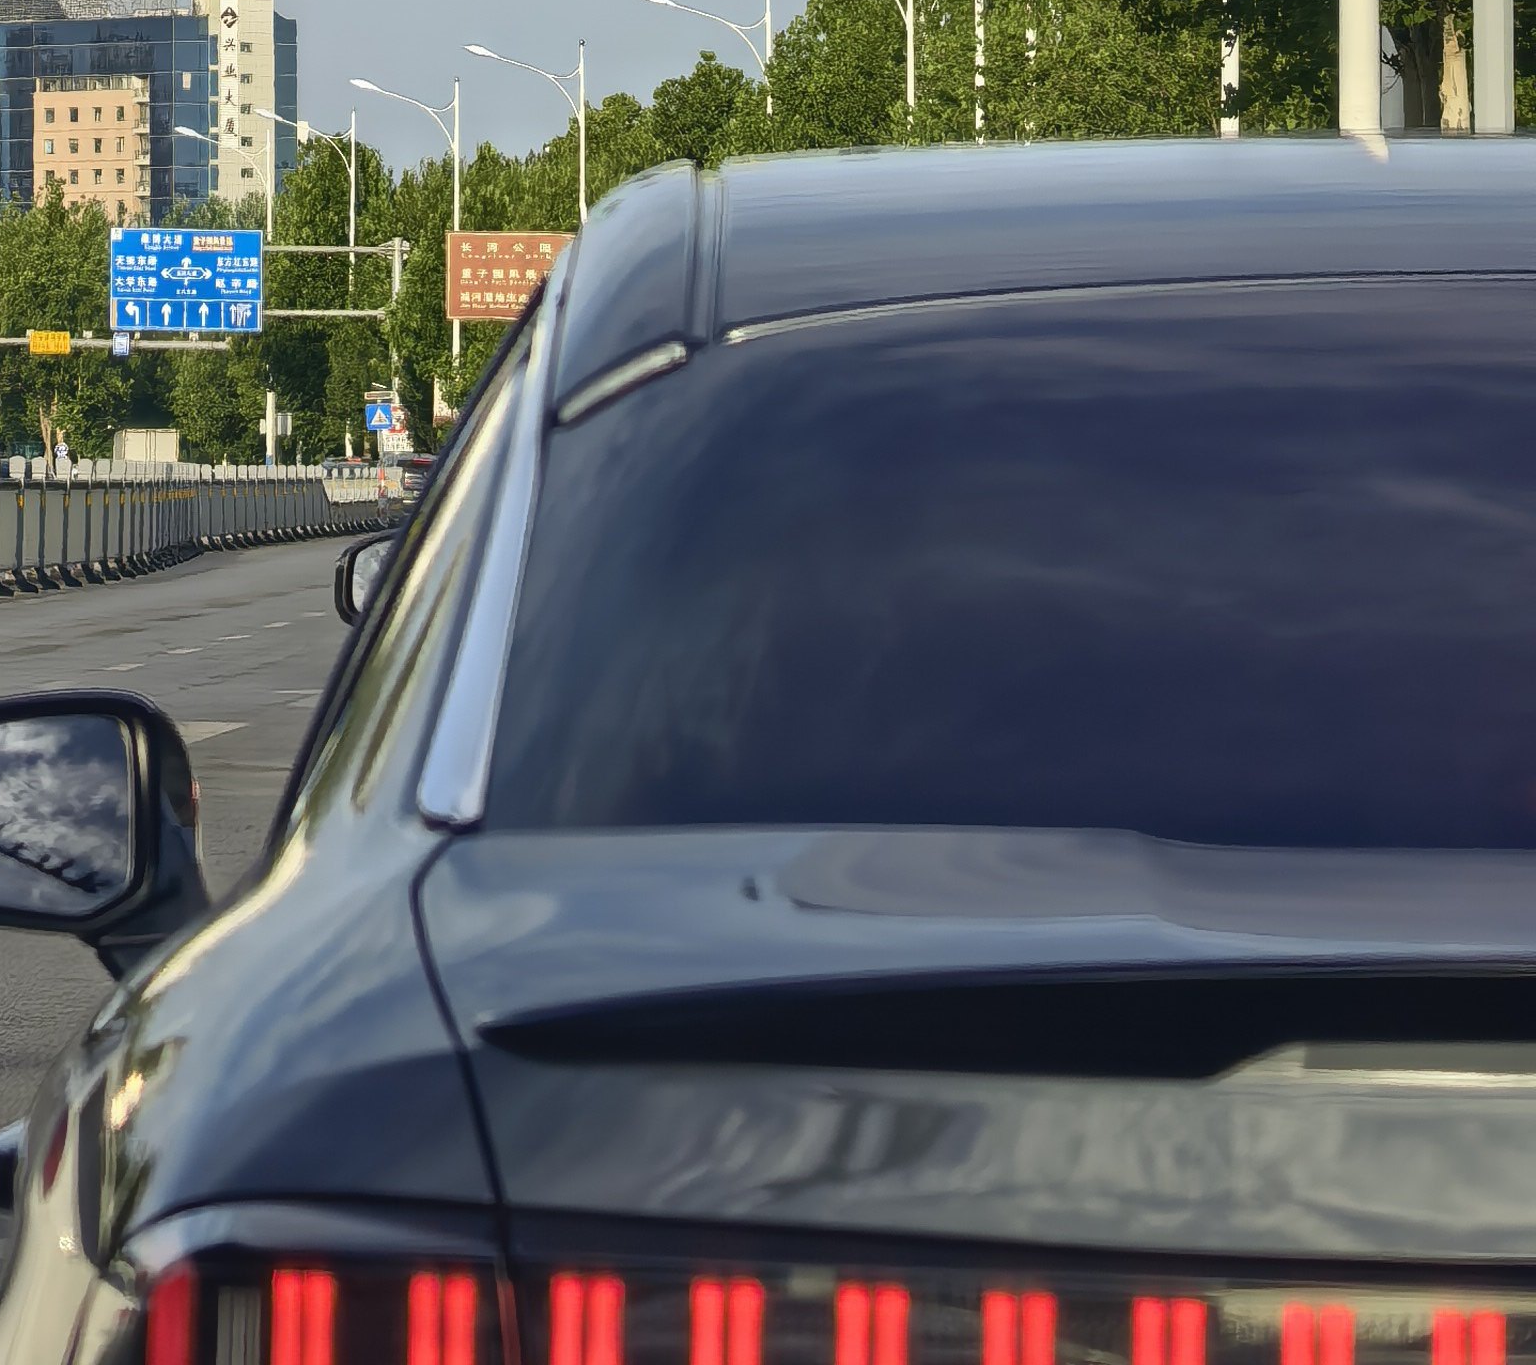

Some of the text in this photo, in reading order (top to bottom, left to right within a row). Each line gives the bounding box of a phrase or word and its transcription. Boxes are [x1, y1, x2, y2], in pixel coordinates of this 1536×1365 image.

[222, 38, 238, 137] 兴业大厦
[460, 242, 552, 253] 长河公园
